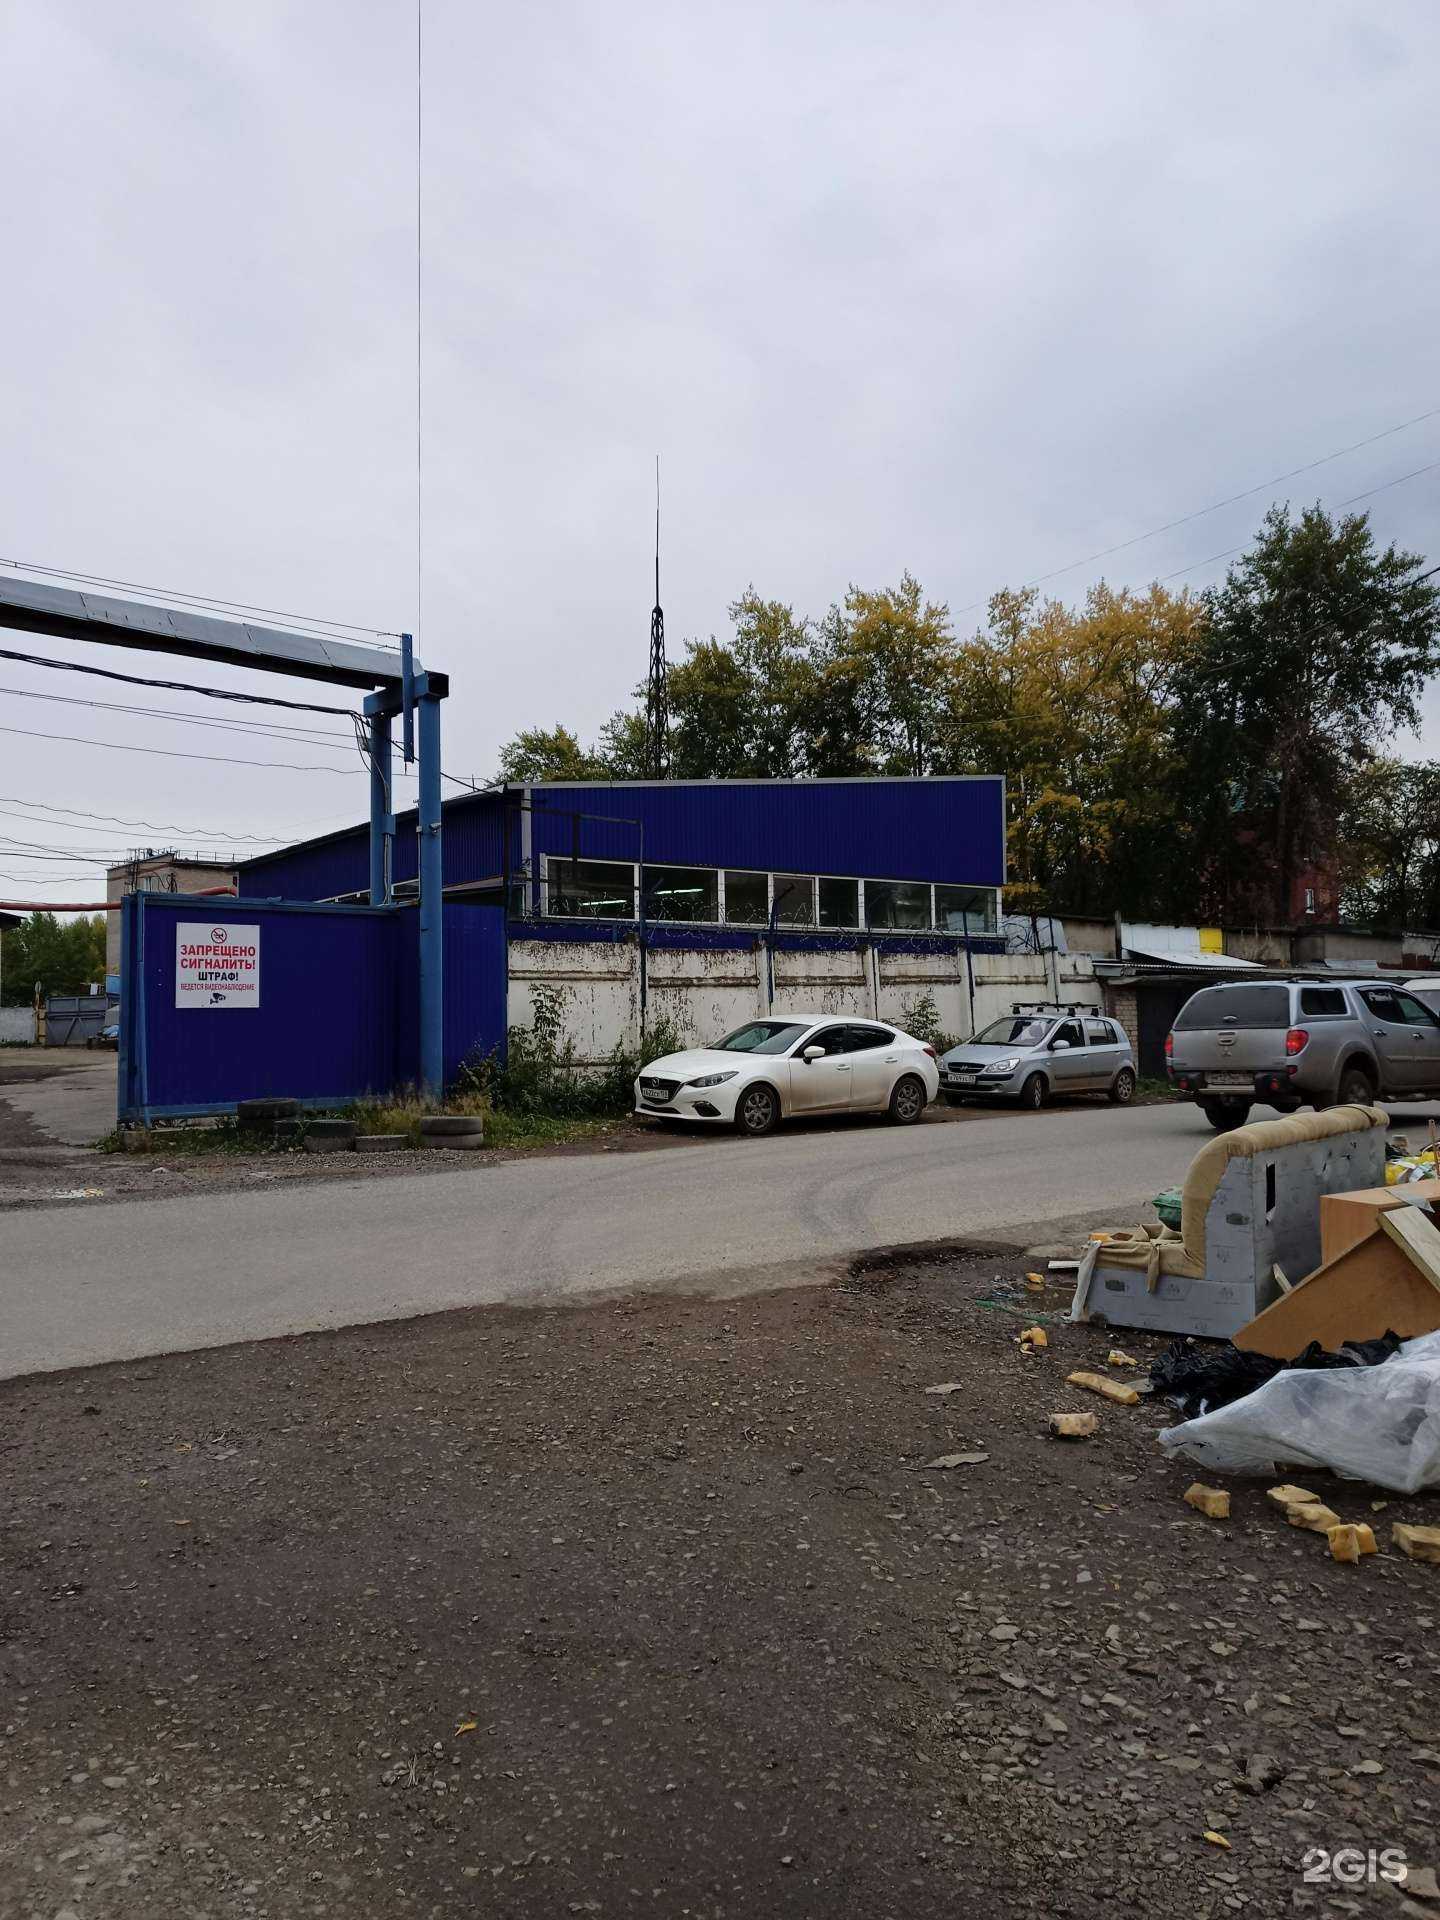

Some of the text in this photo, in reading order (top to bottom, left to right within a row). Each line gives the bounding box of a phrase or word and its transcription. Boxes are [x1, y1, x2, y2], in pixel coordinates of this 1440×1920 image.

[180, 945, 256, 958] ЗАПРЕЩЕНО
[180, 958, 256, 970] СИГНАЛИТЬ!
[198, 971, 239, 981] ШТРАФ!
